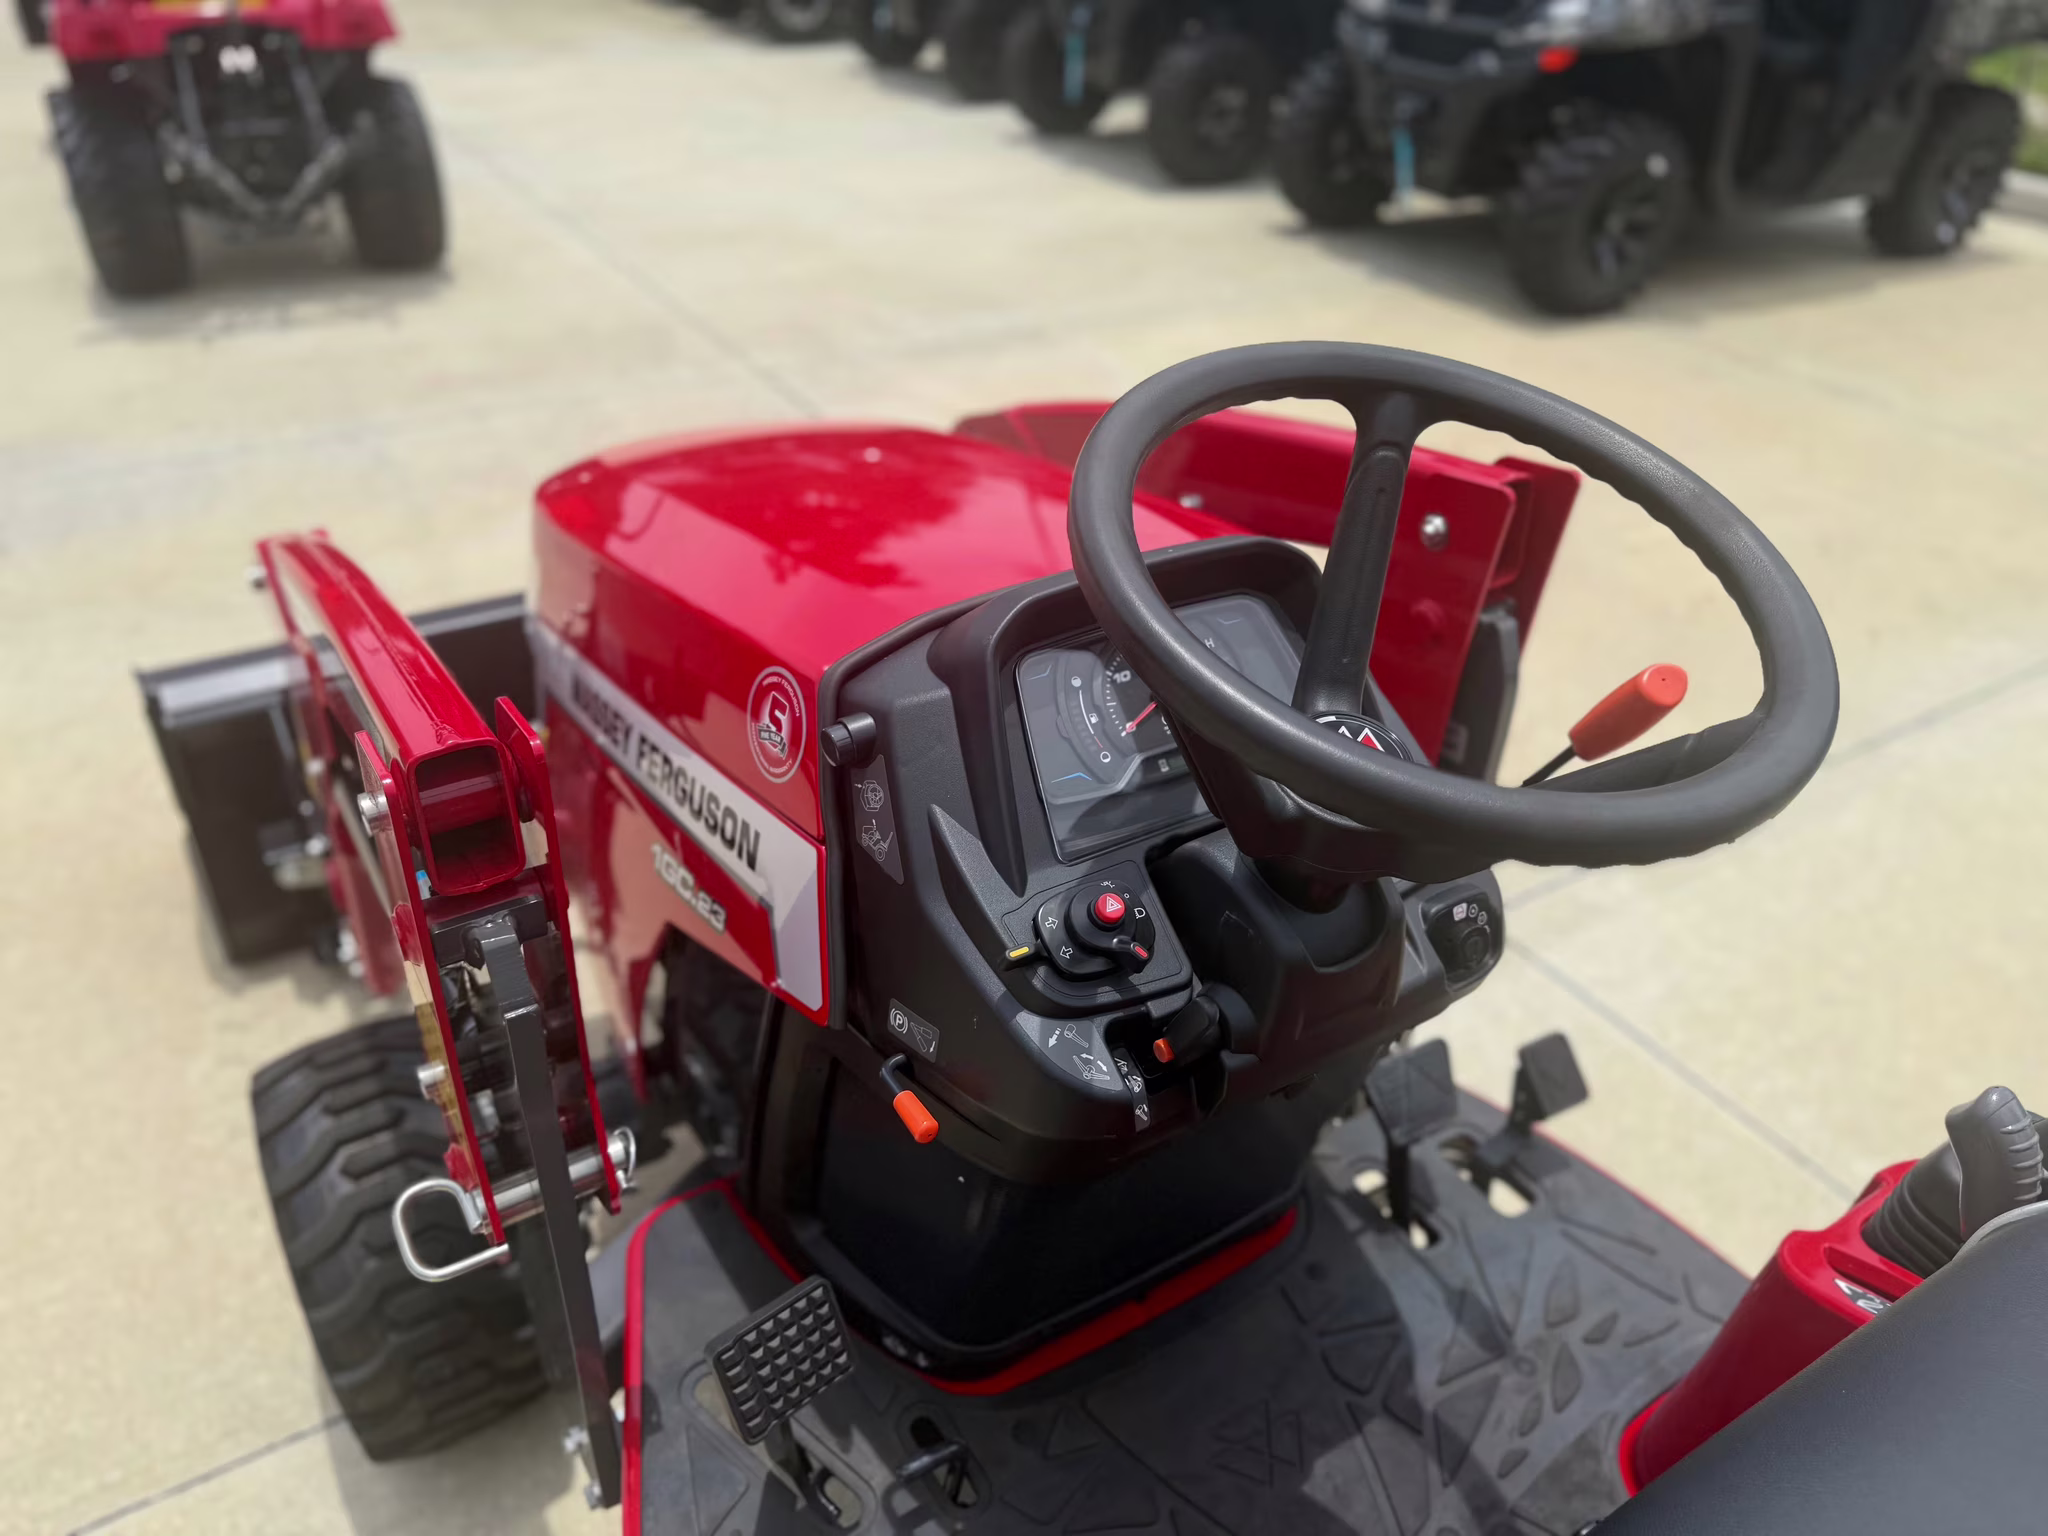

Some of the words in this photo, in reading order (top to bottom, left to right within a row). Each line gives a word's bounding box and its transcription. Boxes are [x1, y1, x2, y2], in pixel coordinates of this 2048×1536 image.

[1112, 670, 1132, 684] 10
[781, 679, 800, 717] FERGUSON
[638, 731, 761, 873] FERGUSON
